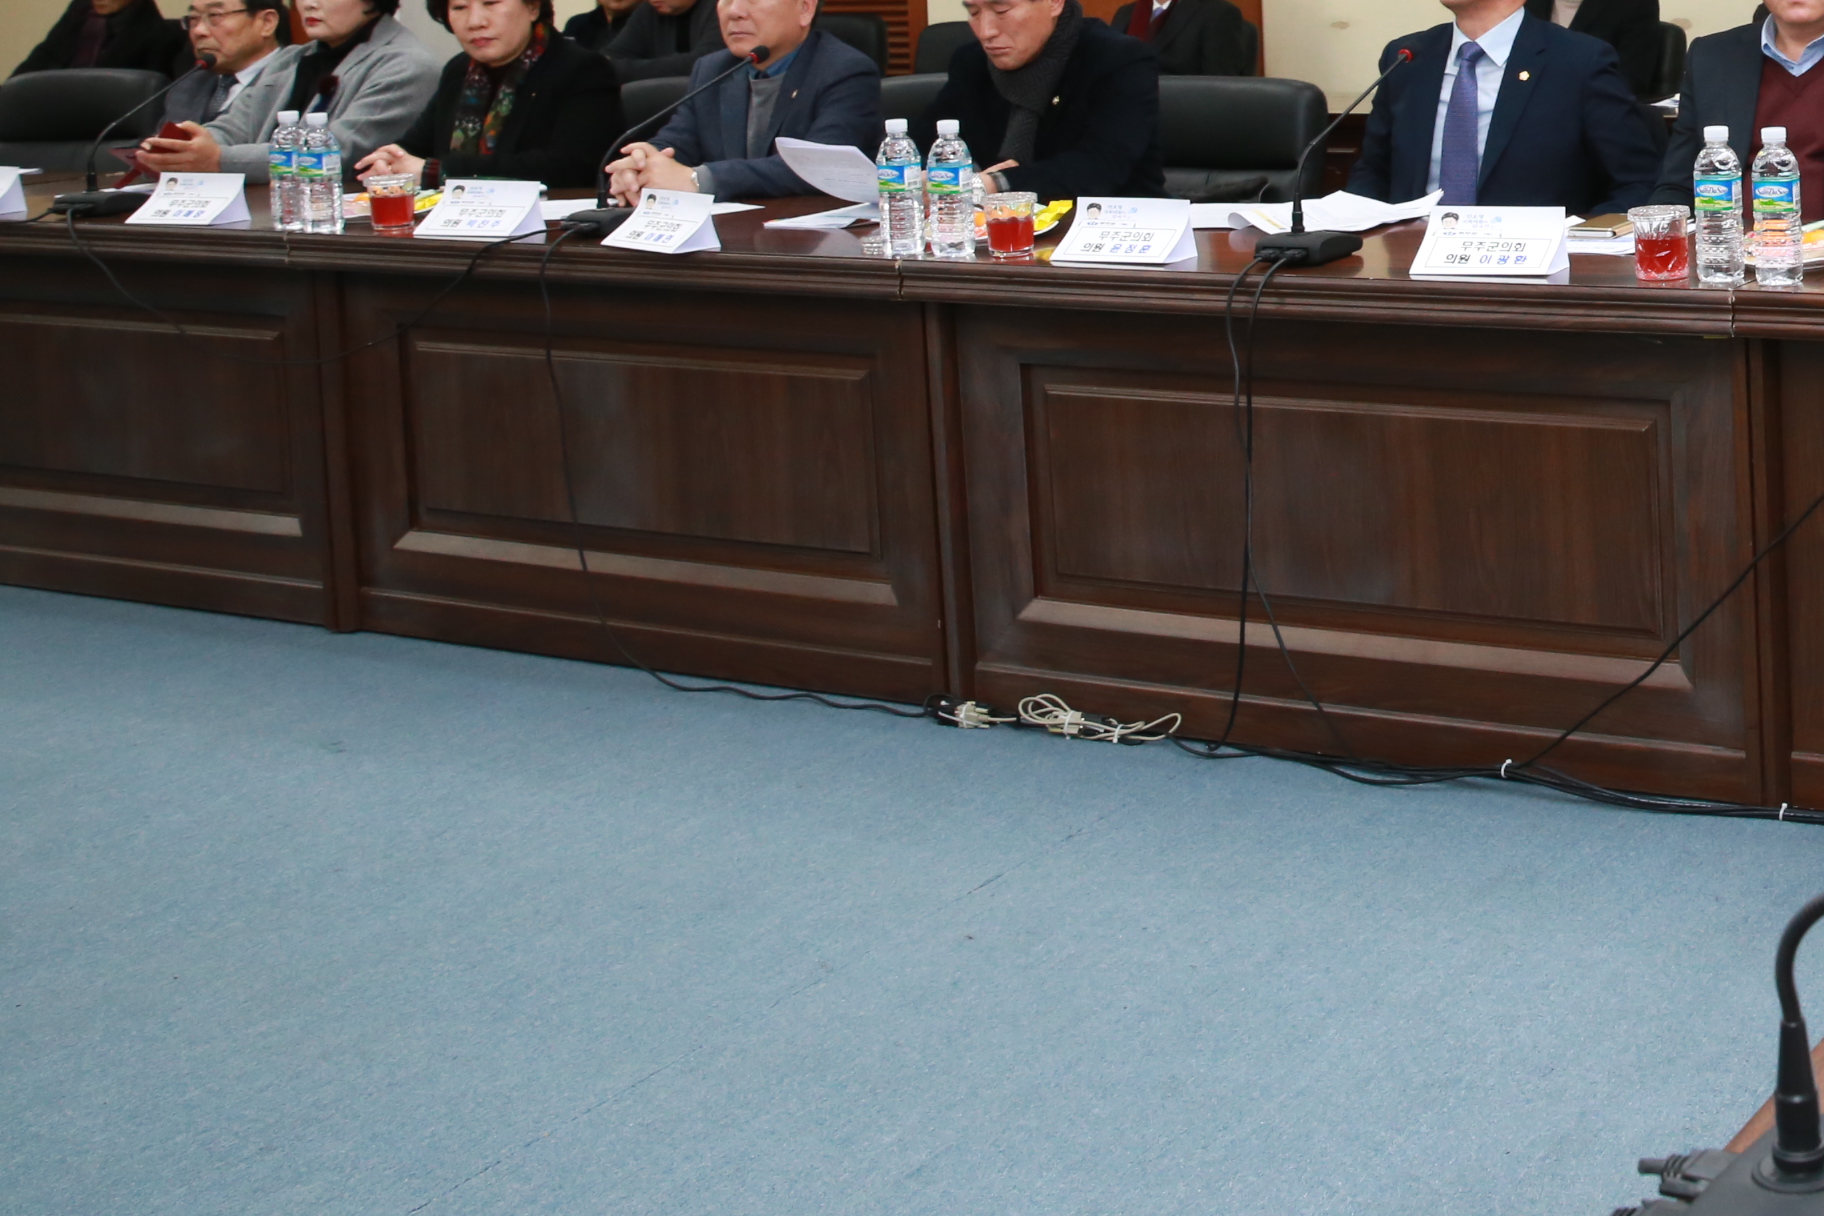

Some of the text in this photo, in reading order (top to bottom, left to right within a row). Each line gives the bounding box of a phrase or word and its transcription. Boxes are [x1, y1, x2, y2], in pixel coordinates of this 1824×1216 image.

[1098, 231, 1155, 242] 무주군의회
[1080, 243, 1105, 253] 의원
[1460, 241, 1527, 252] 무주군의회
[1444, 254, 1471, 264] 의원
